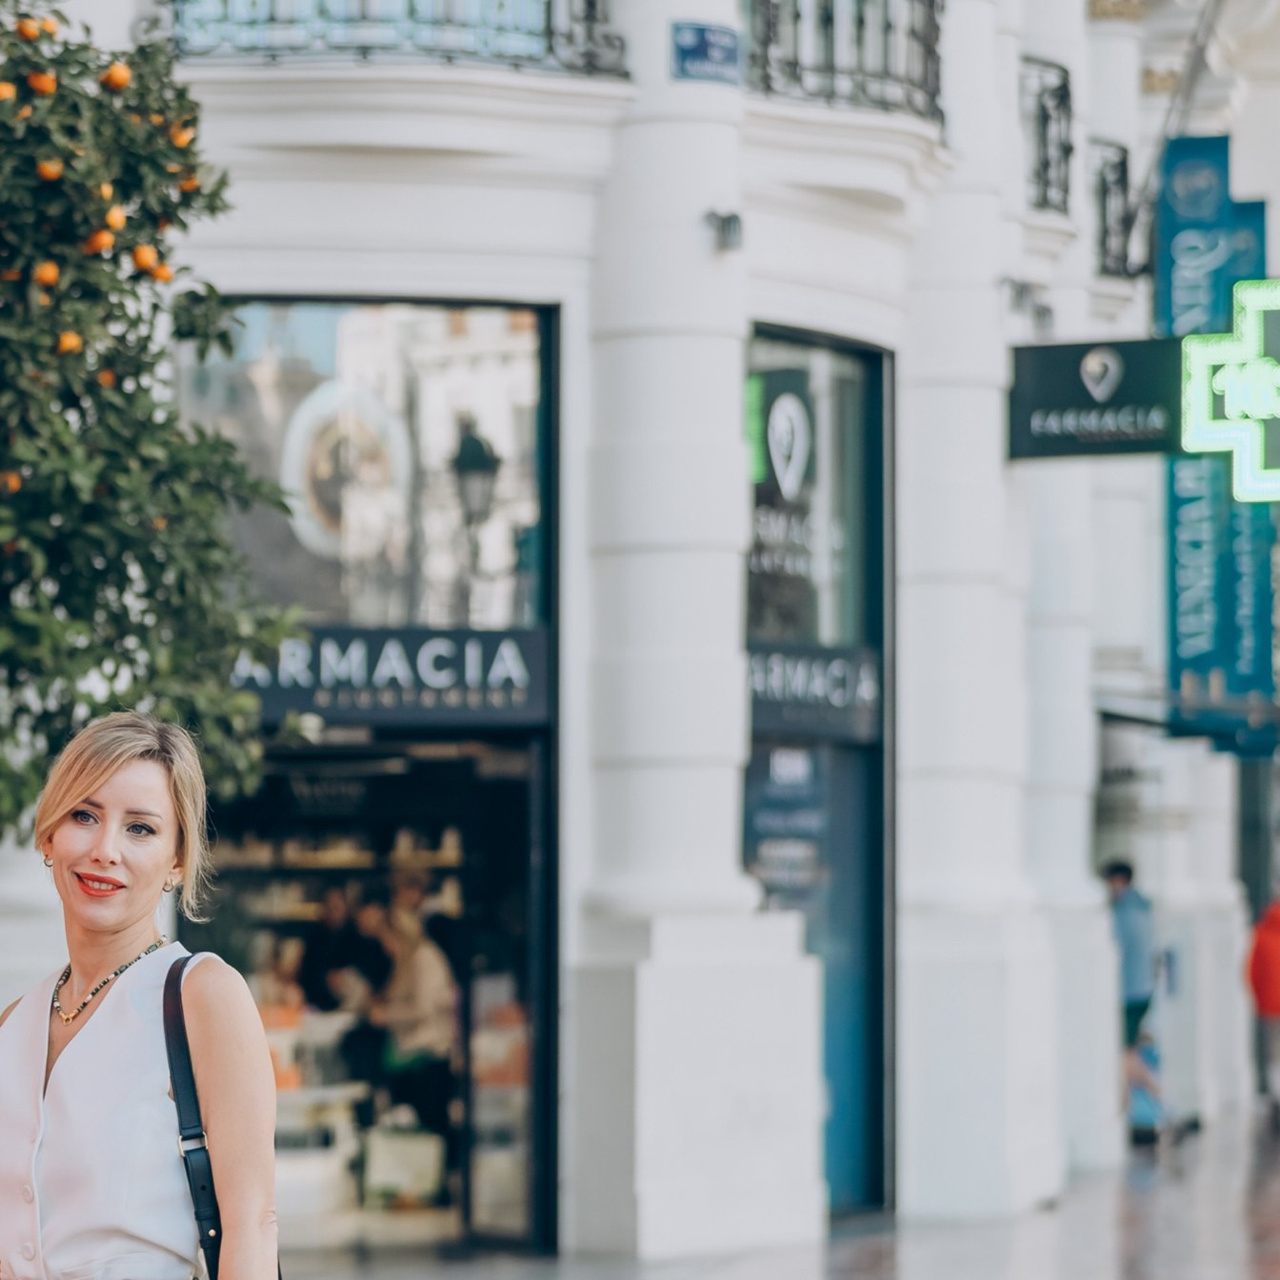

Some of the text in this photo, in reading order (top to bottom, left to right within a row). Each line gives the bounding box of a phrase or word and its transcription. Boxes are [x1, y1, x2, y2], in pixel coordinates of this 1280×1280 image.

[1030, 405, 1168, 438] FARMACIA
[230, 637, 530, 689] ARMACIA
[750, 653, 879, 708] ARMACIA
